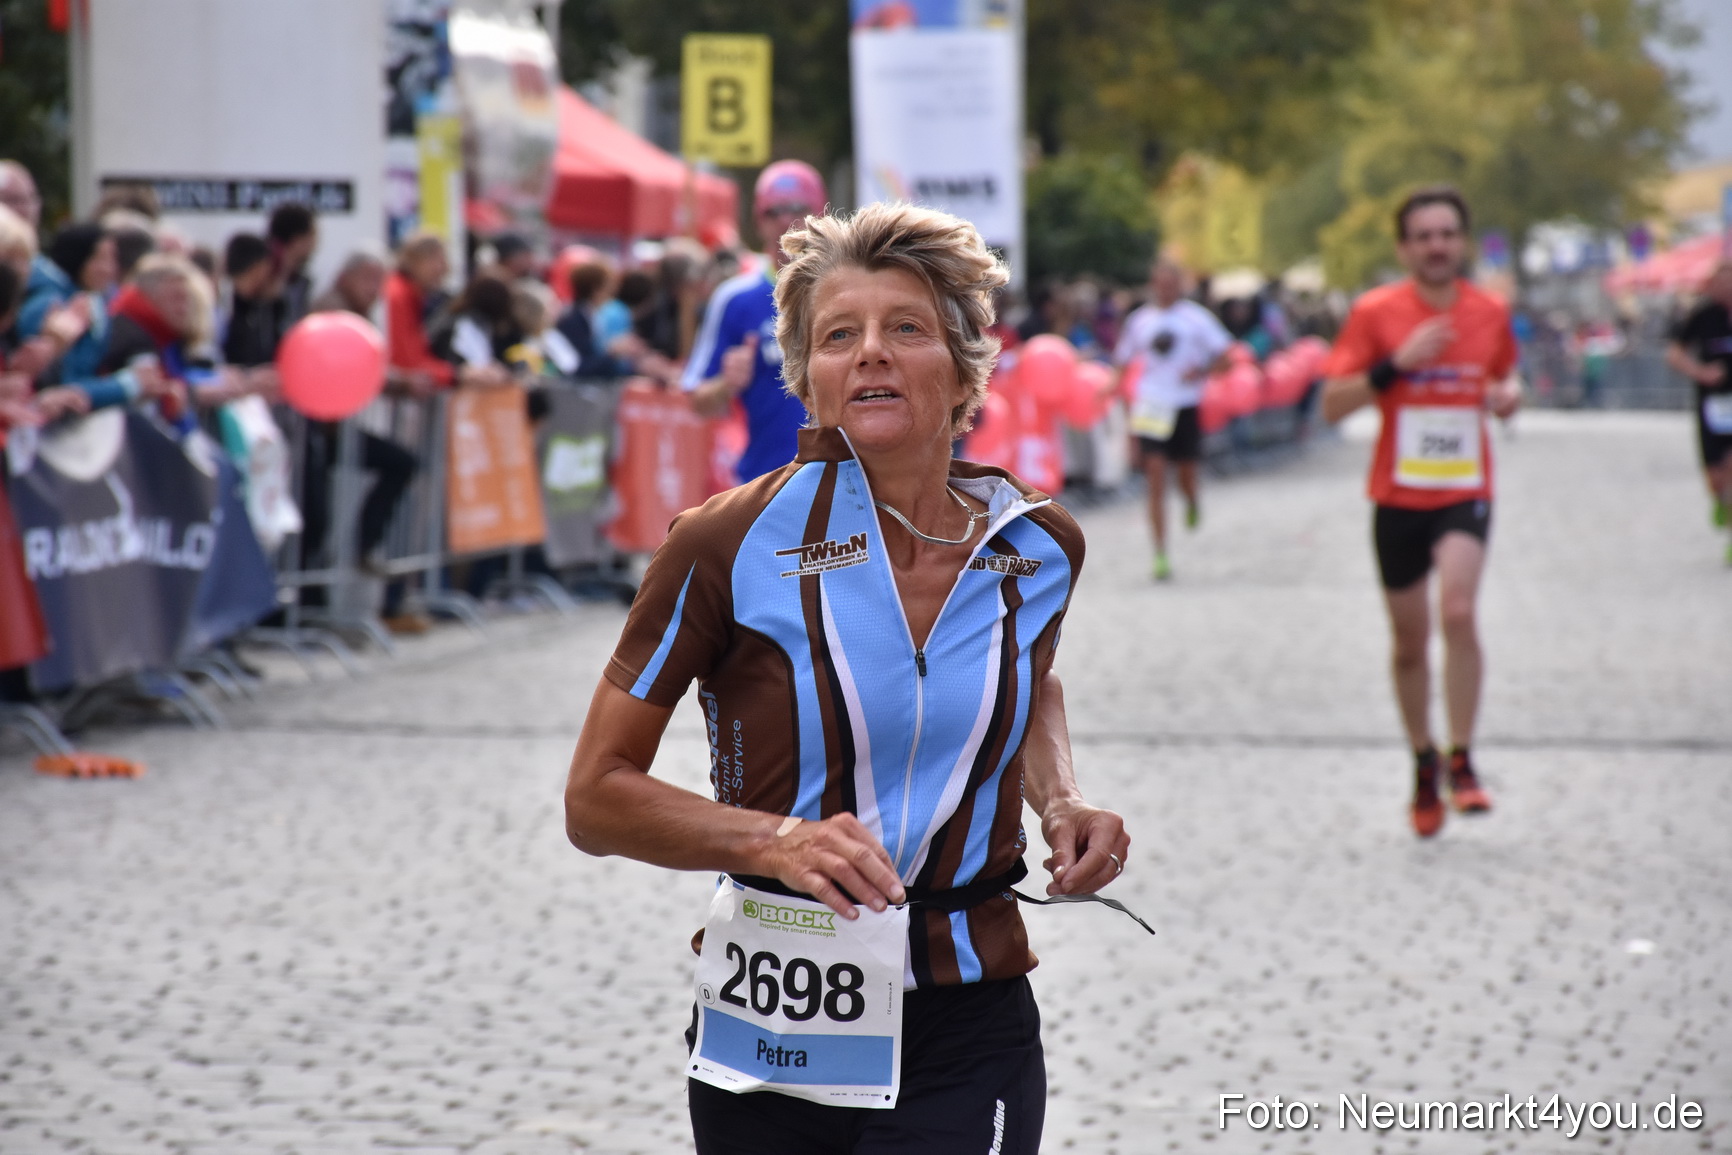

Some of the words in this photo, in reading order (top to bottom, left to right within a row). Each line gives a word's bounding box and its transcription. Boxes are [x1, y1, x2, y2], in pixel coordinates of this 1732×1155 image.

[708, 77, 747, 135] B
[760, 903, 836, 931] BOCK
[808, 929, 837, 938] concepts
[719, 941, 866, 1023] 2698
[757, 1038, 808, 1068] Petra
